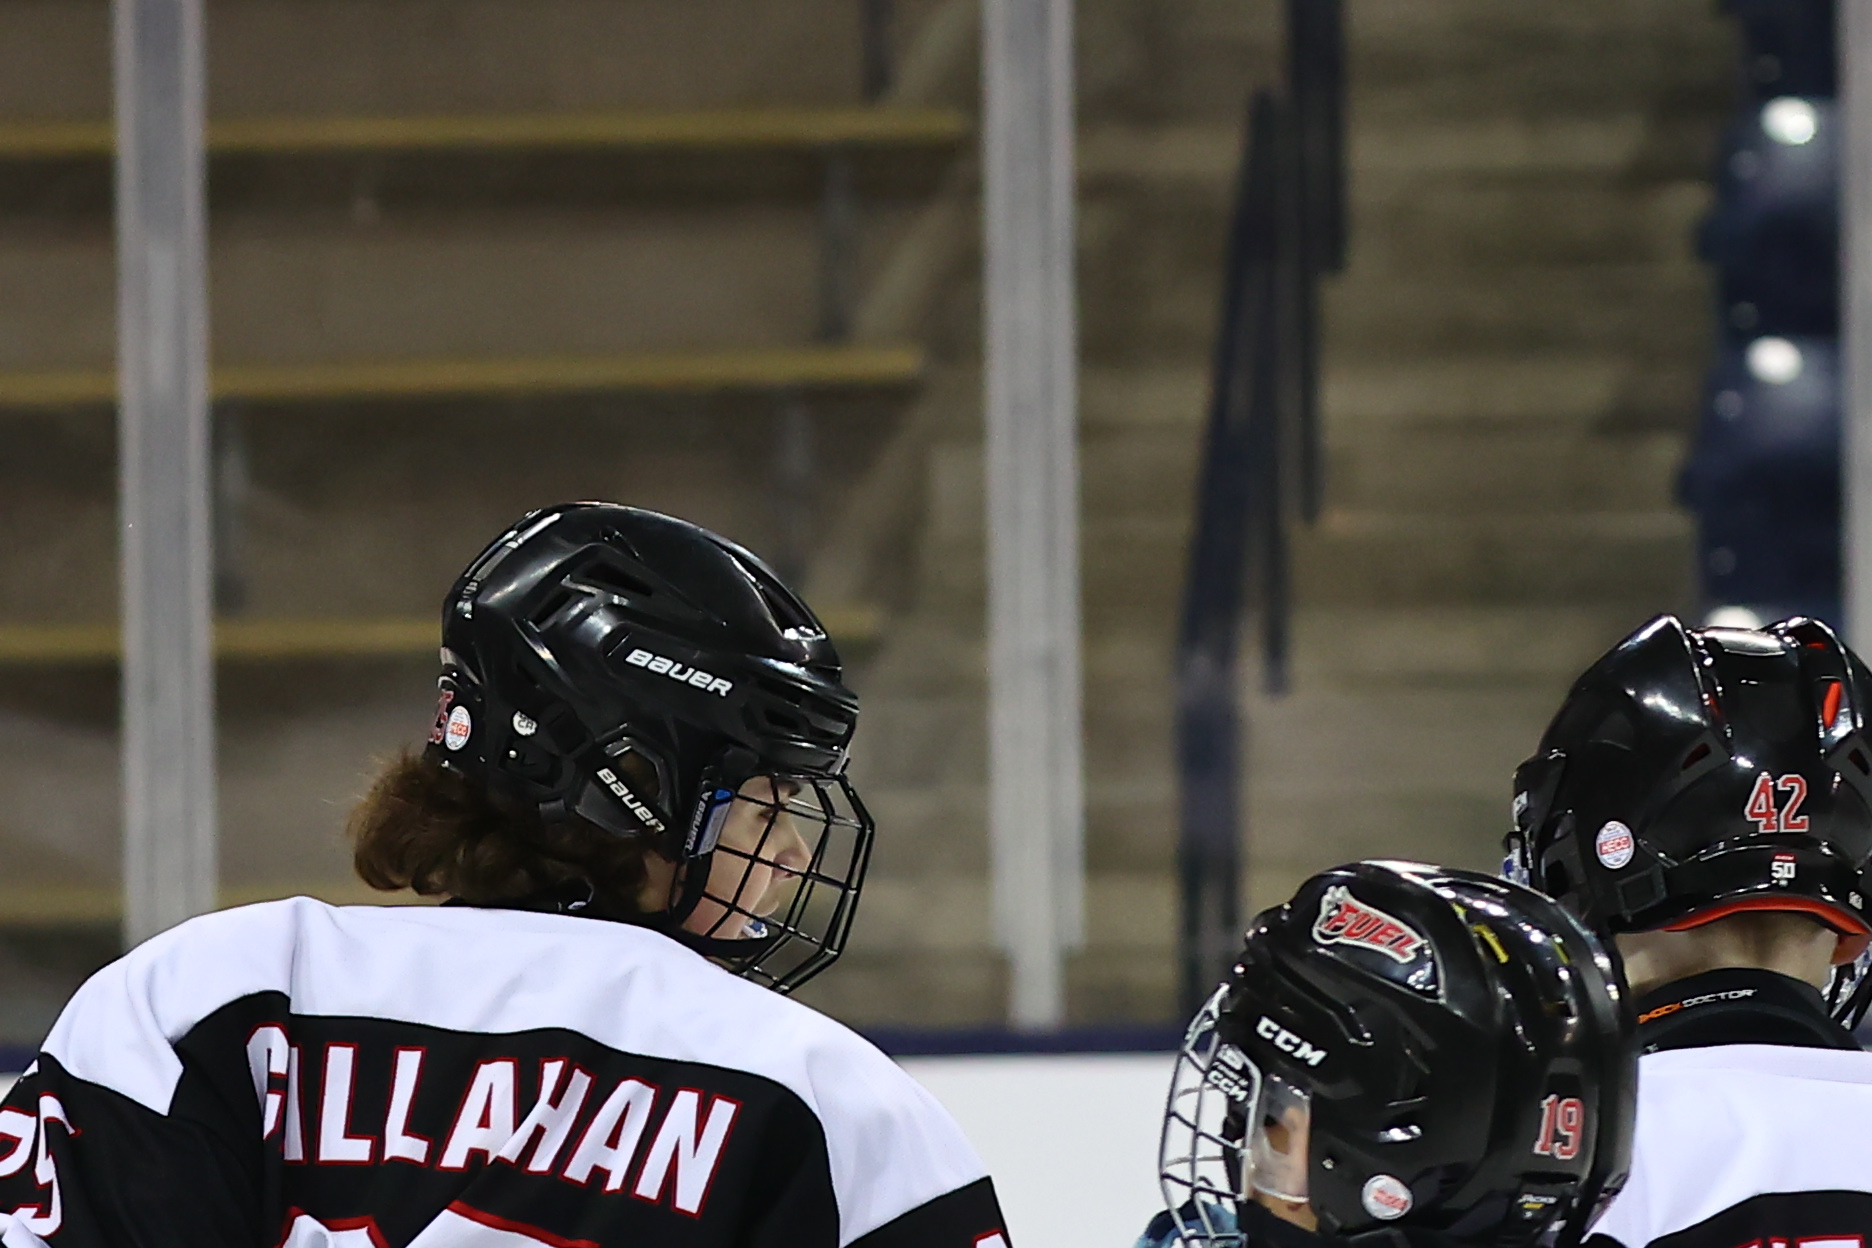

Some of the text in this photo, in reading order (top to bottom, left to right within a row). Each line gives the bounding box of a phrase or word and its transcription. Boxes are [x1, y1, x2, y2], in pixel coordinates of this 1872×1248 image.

[625, 649, 733, 697] BAUER
[1744, 774, 1809, 833] 42
[1322, 901, 1418, 960] FUEL
[1256, 1015, 1329, 1067] CCM
[1207, 1070, 1248, 1101] CCM
[1533, 1093, 1583, 1160] 19
